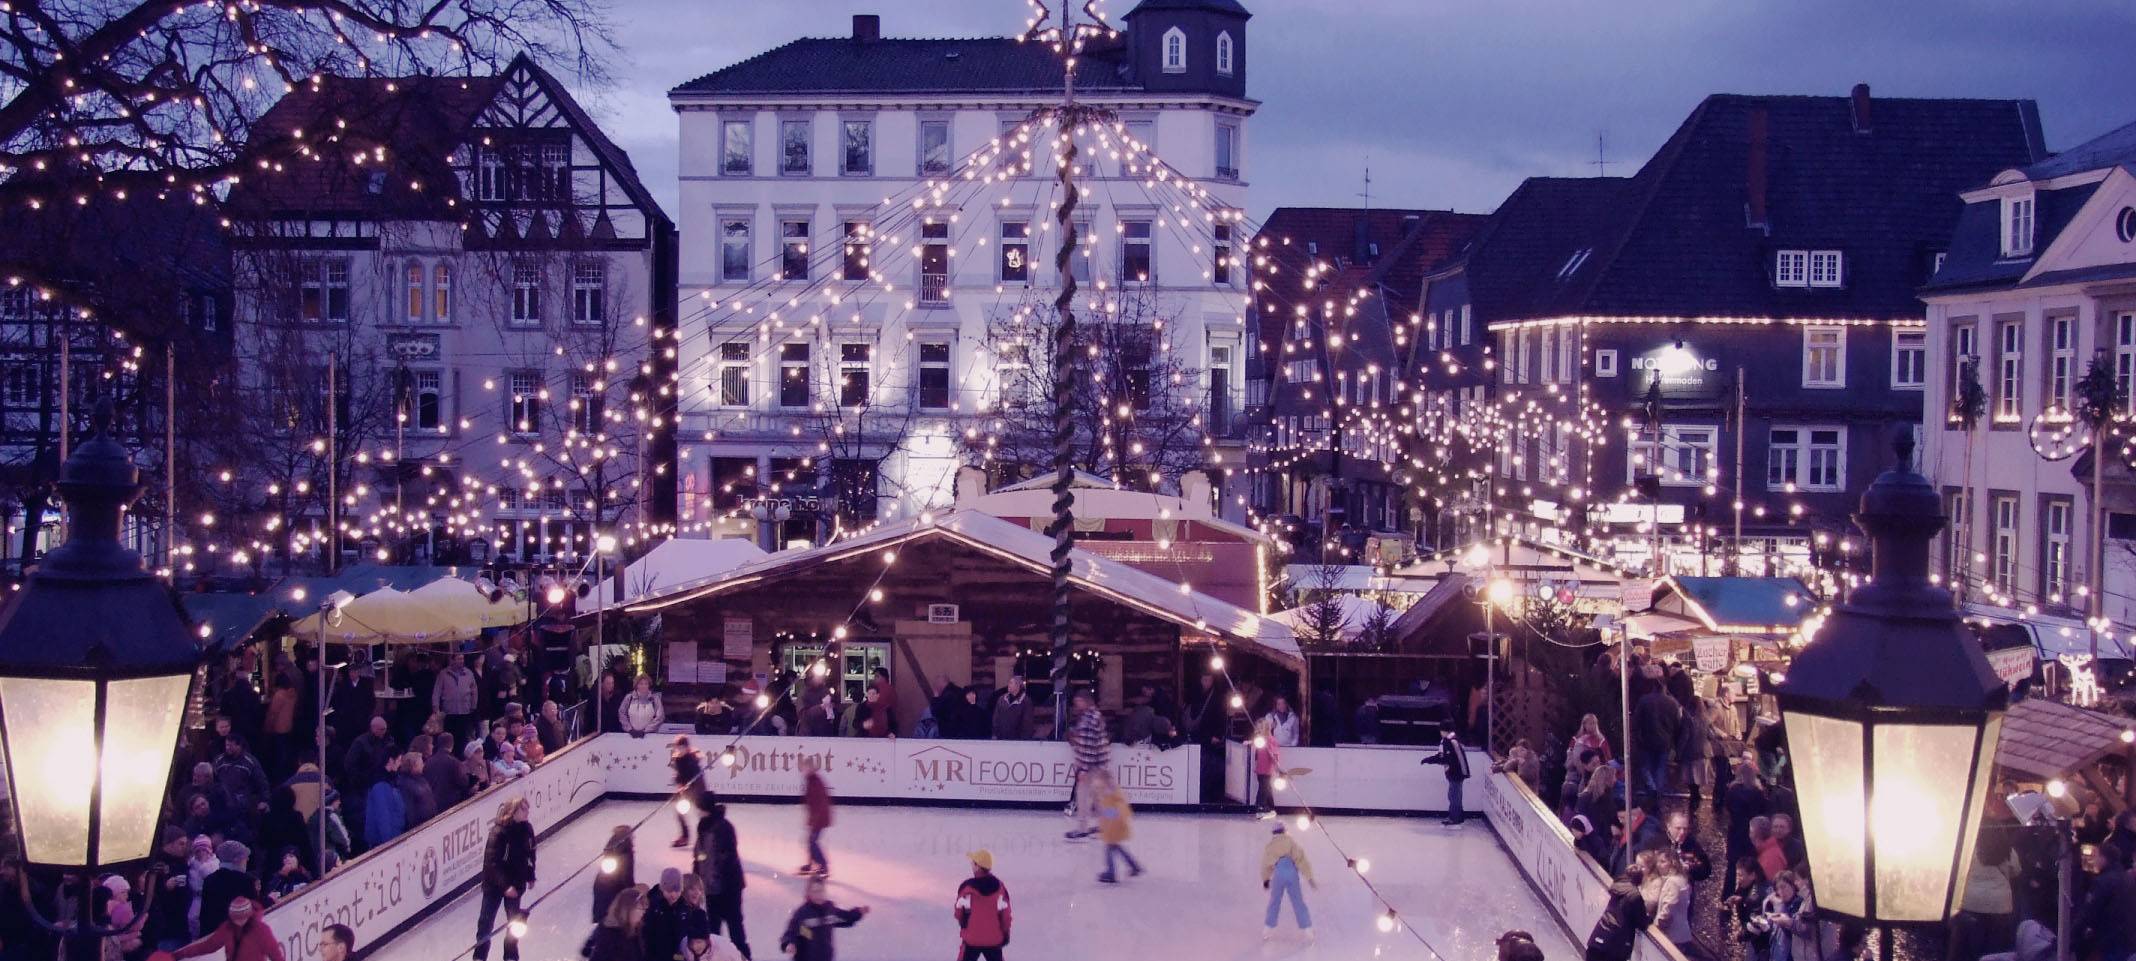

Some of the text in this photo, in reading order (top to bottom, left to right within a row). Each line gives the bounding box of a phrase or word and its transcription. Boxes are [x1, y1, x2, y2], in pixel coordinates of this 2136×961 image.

[980, 761, 1044, 783] FOOD
[1053, 763, 1174, 787] FAITIES
[442, 817, 483, 864] RITZEL
